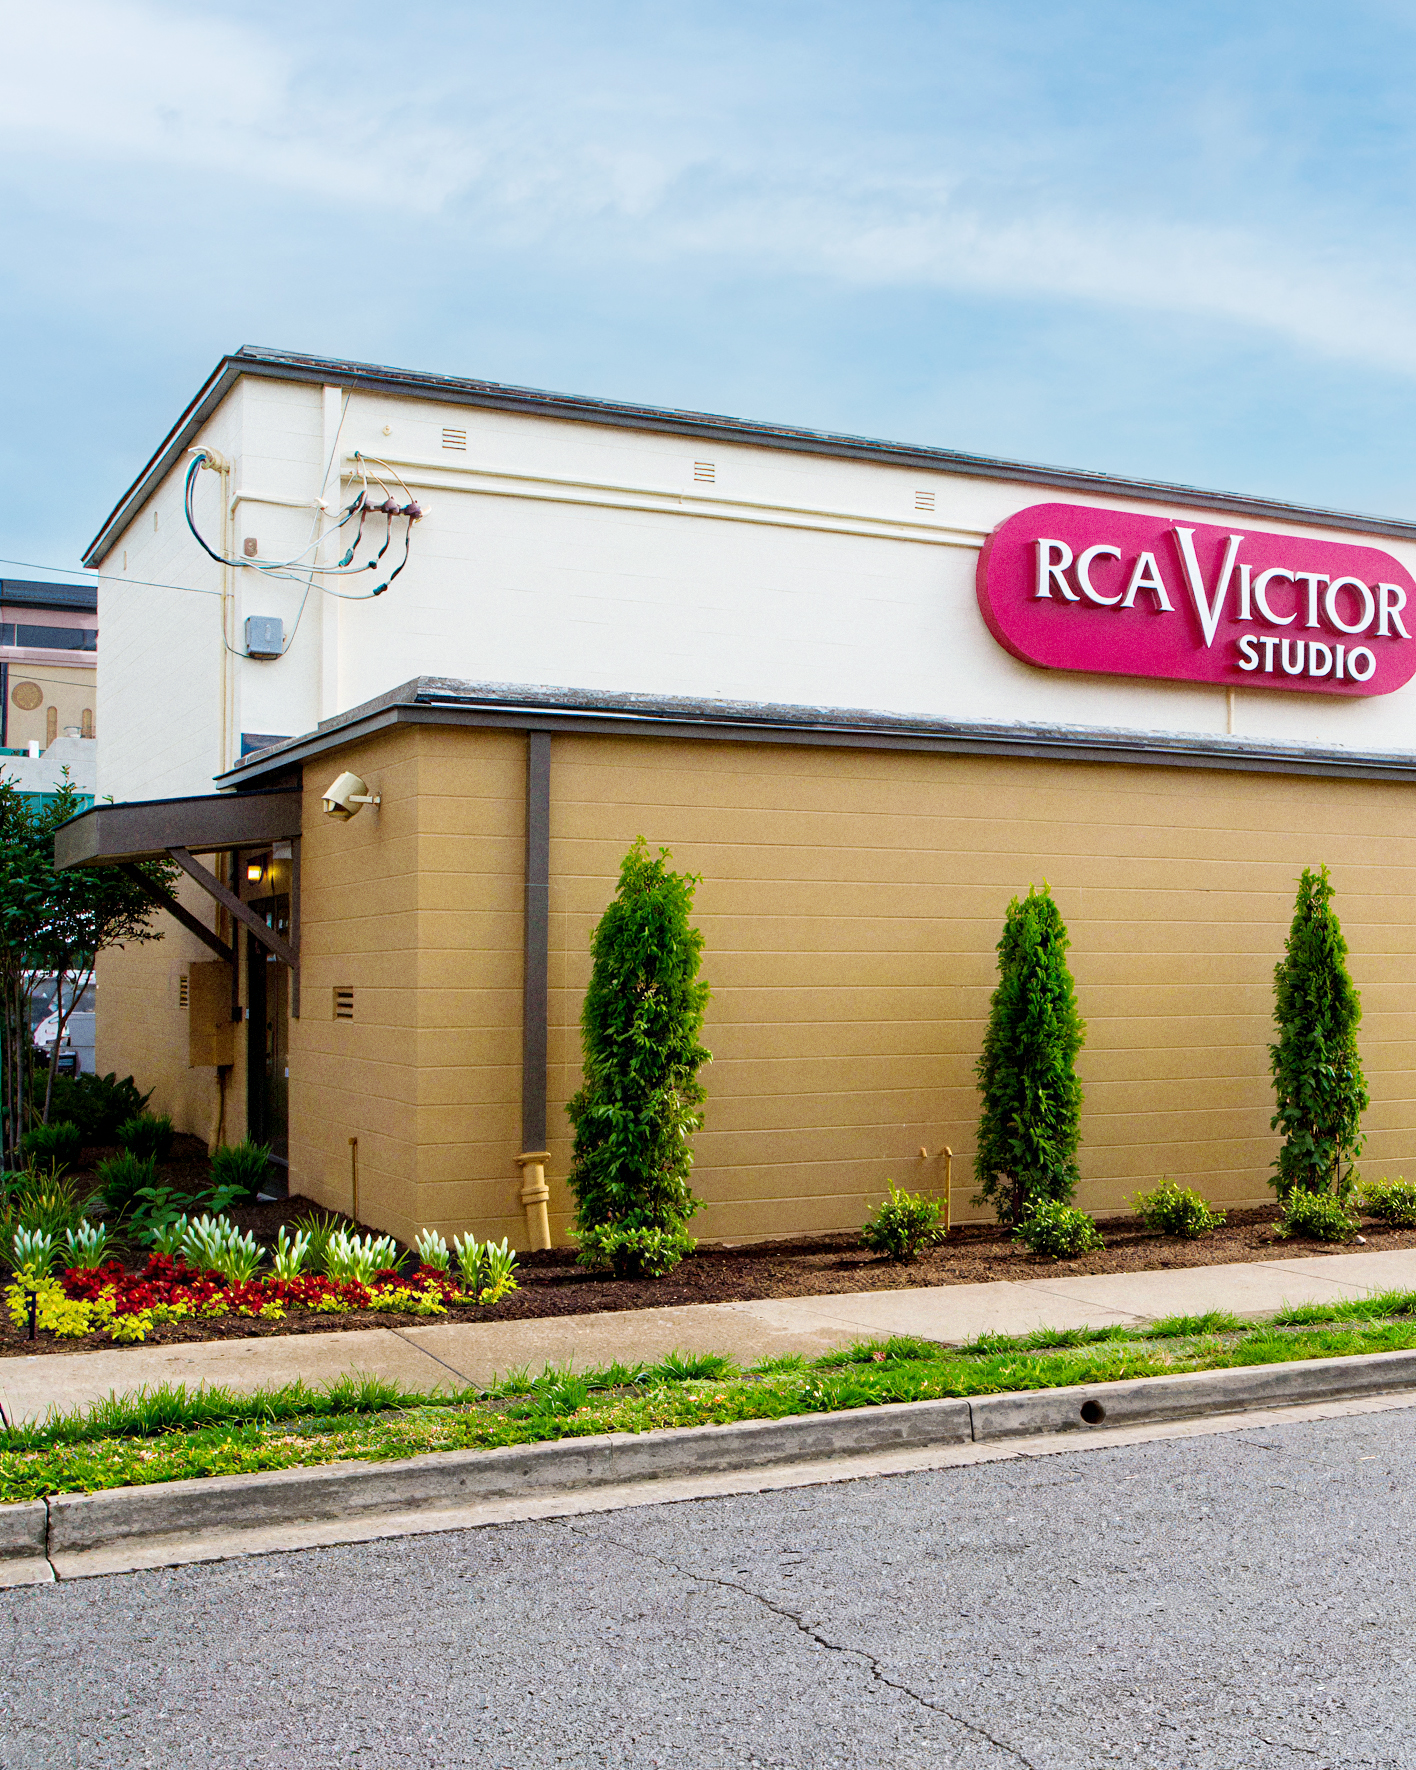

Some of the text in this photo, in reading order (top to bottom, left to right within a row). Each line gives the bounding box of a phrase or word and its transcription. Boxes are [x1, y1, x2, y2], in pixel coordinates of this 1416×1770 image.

[1034, 525, 1413, 650] RCA VICTOR
[1237, 633, 1378, 683] STUDIO
